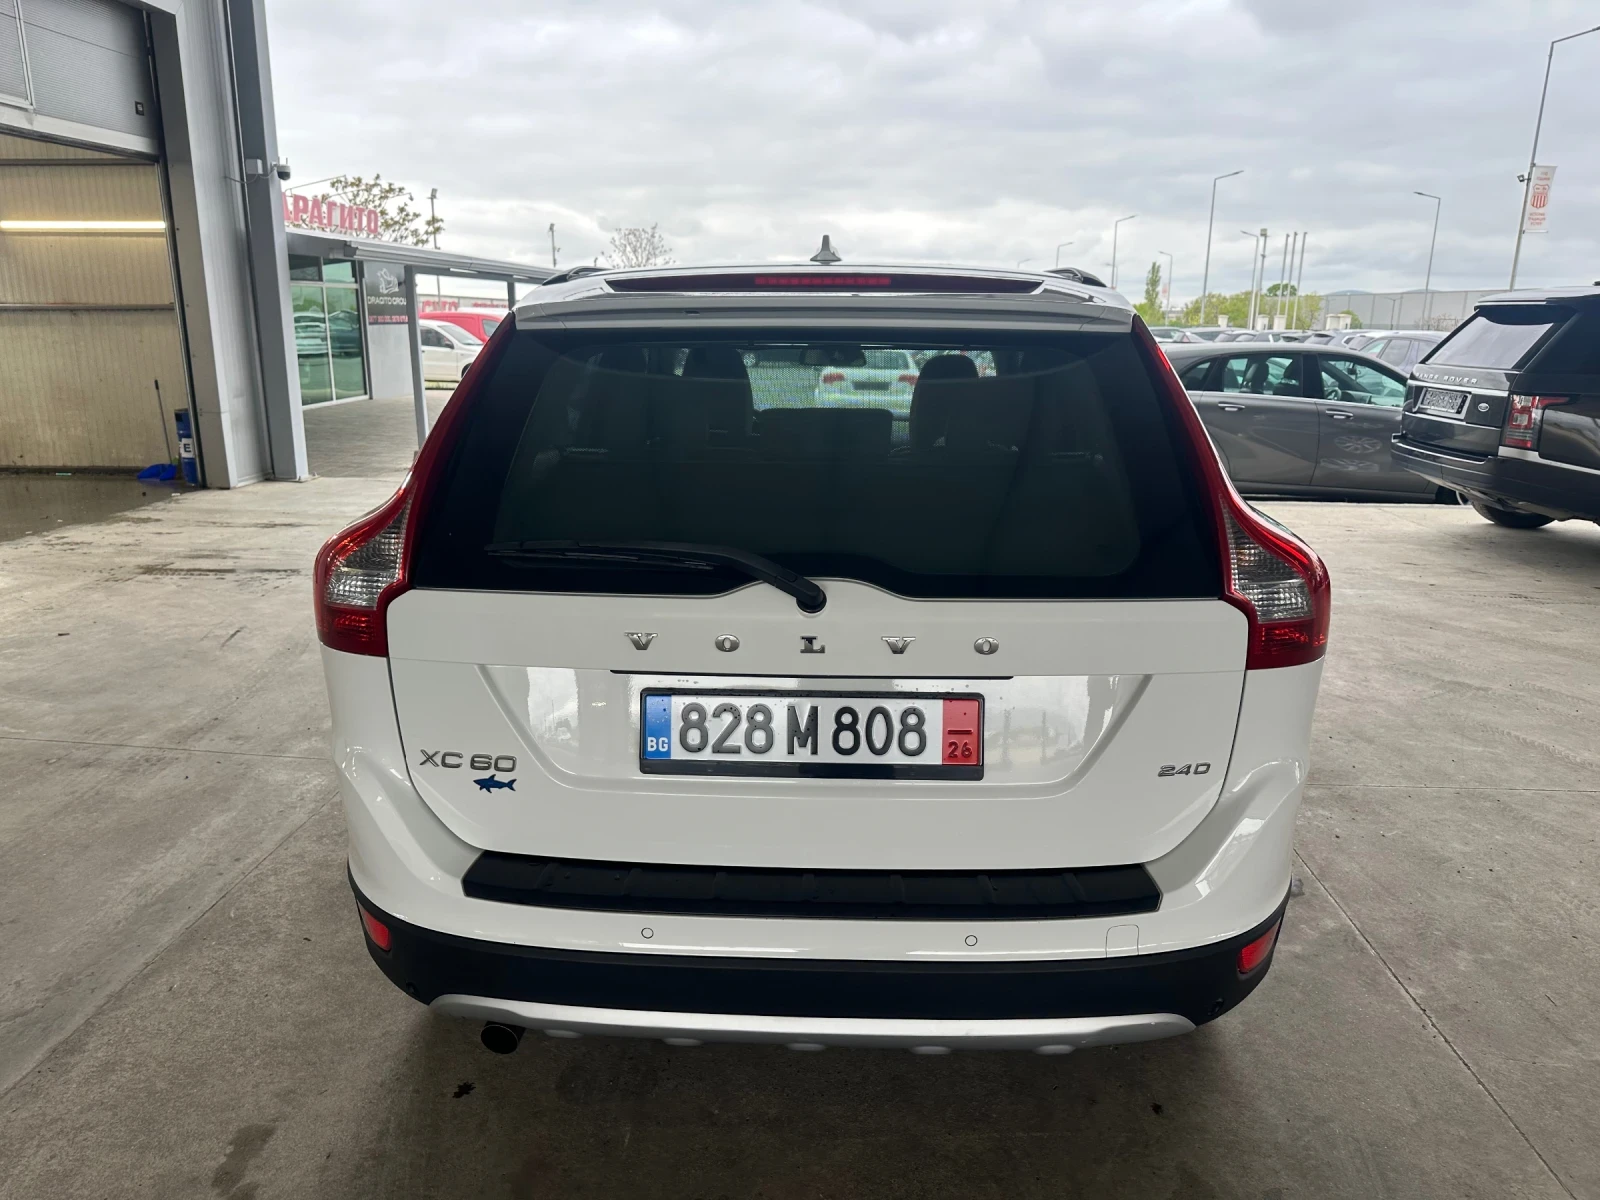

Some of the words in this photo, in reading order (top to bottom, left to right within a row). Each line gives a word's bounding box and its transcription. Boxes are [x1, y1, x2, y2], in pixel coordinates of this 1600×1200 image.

[1443, 375, 1478, 384] ROVER
[624, 632, 999, 655] VOLVO
[679, 702, 774, 755] 828
[786, 705, 819, 756] M
[831, 706, 927, 757] 808
[647, 736, 669, 752] BG
[948, 742, 973, 759] 26
